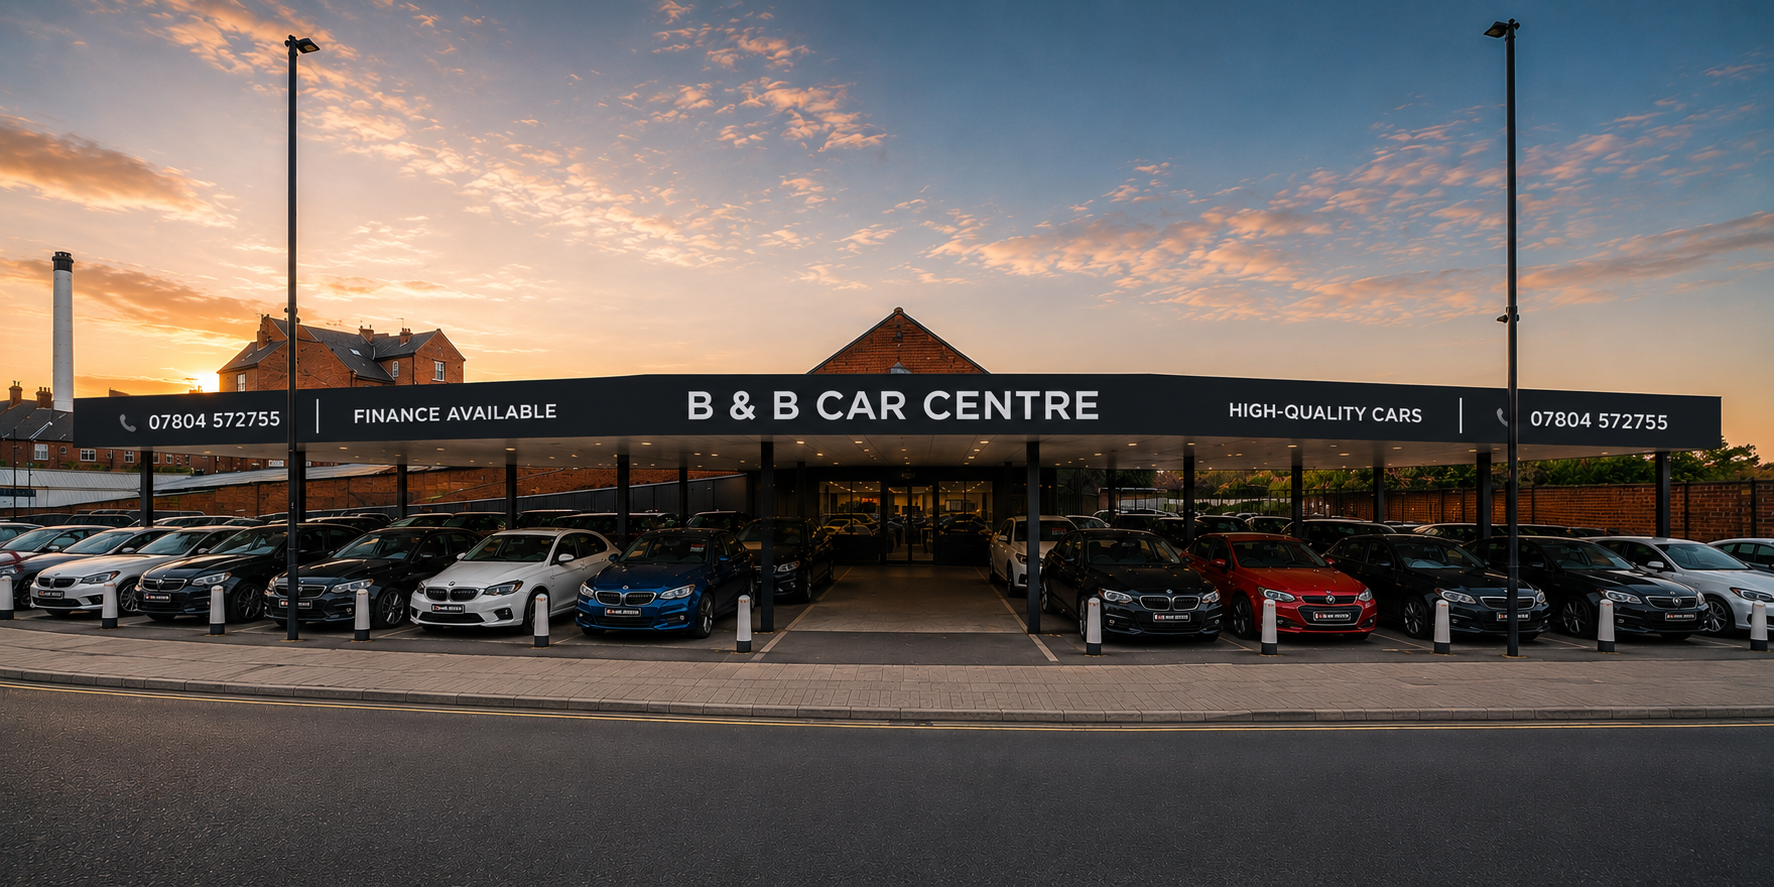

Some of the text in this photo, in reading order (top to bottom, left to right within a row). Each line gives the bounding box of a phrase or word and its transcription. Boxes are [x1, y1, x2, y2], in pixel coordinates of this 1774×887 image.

[354, 403, 557, 424] FINANCE AVAILABLE
[687, 390, 1099, 421] B & B CAR CENTRE
[1229, 402, 1423, 423] HIGH-QUALITY CARS
[148, 410, 280, 430] 07804 572755
[1530, 410, 1668, 431] 07804 572755
